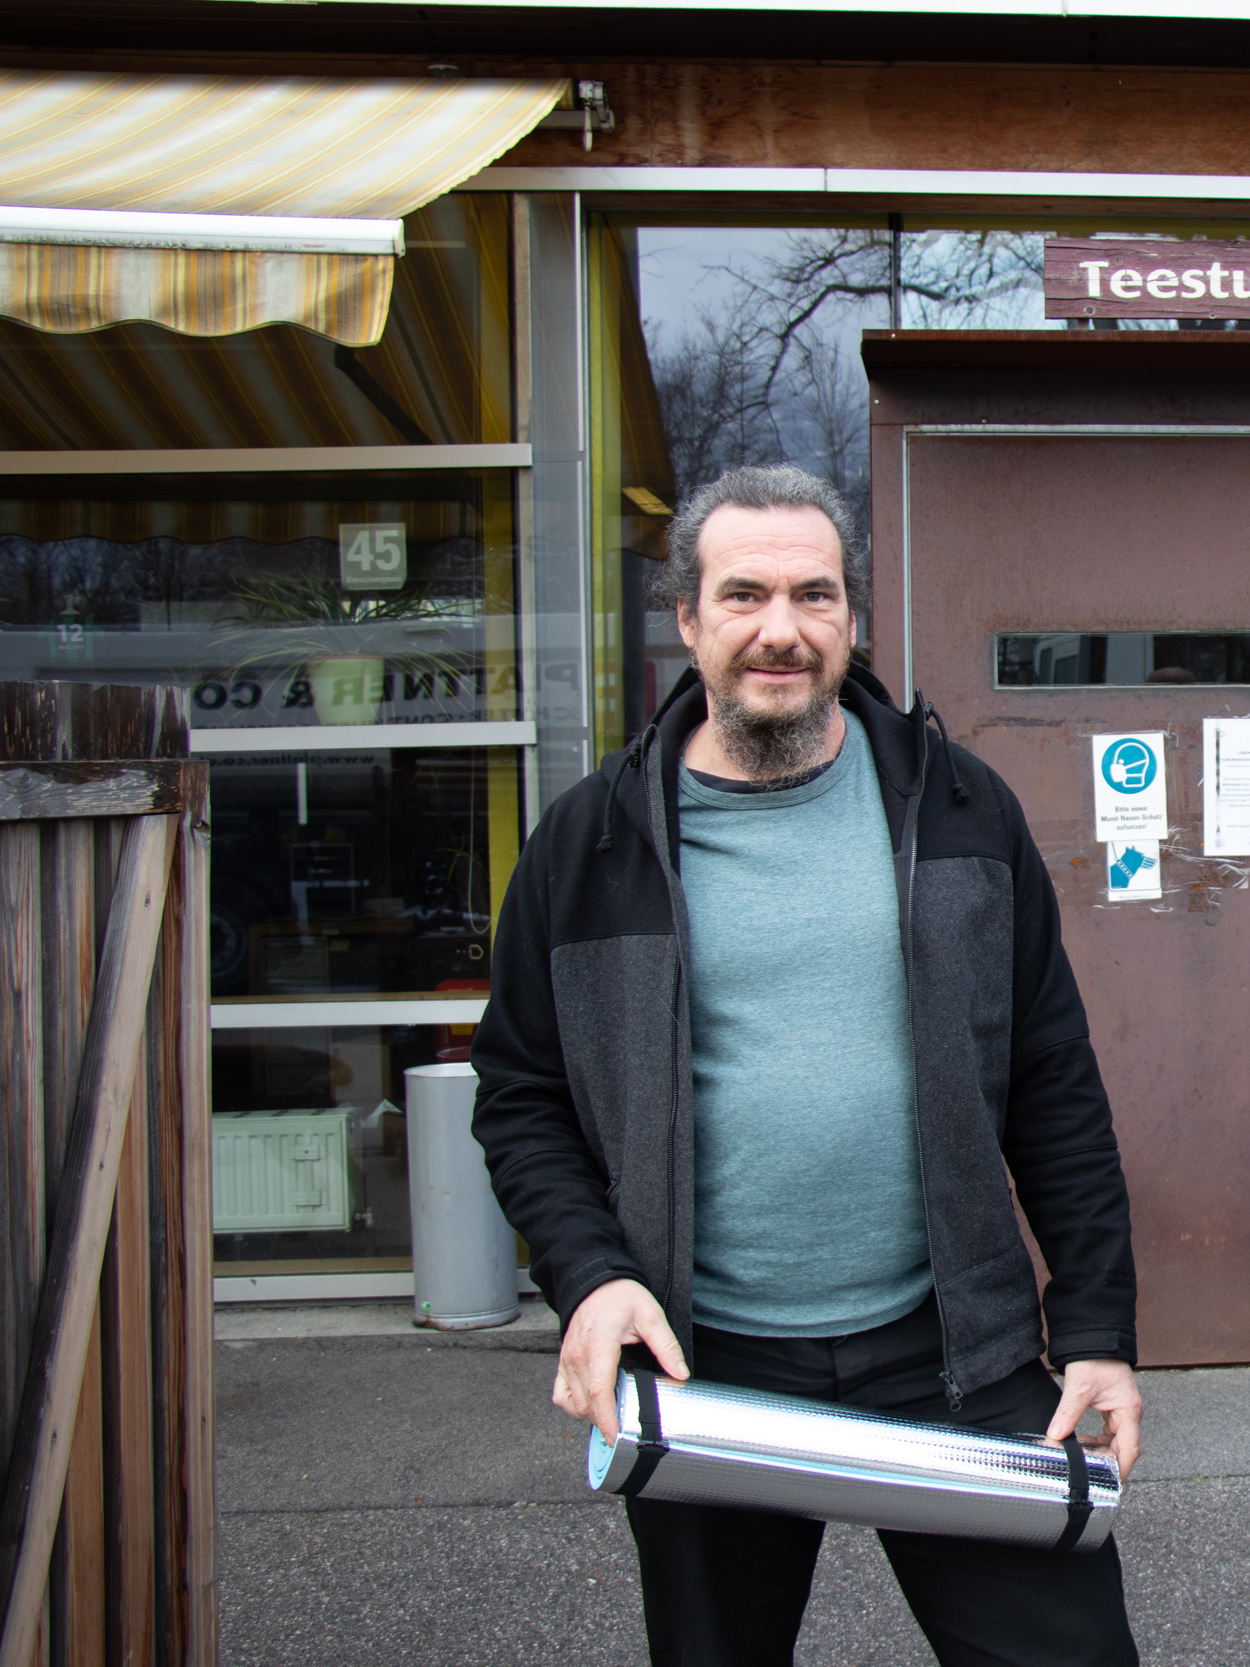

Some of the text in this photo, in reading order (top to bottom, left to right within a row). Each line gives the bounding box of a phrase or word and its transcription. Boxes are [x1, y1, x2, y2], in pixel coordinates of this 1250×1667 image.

[346, 529, 401, 571] 45
[56, 623, 85, 643] 12
[1115, 805, 1130, 813] Bitte
[1100, 813, 1163, 822] Mund-Nasen-Schutz
[1116, 823, 1148, 831] aufsetzen!
